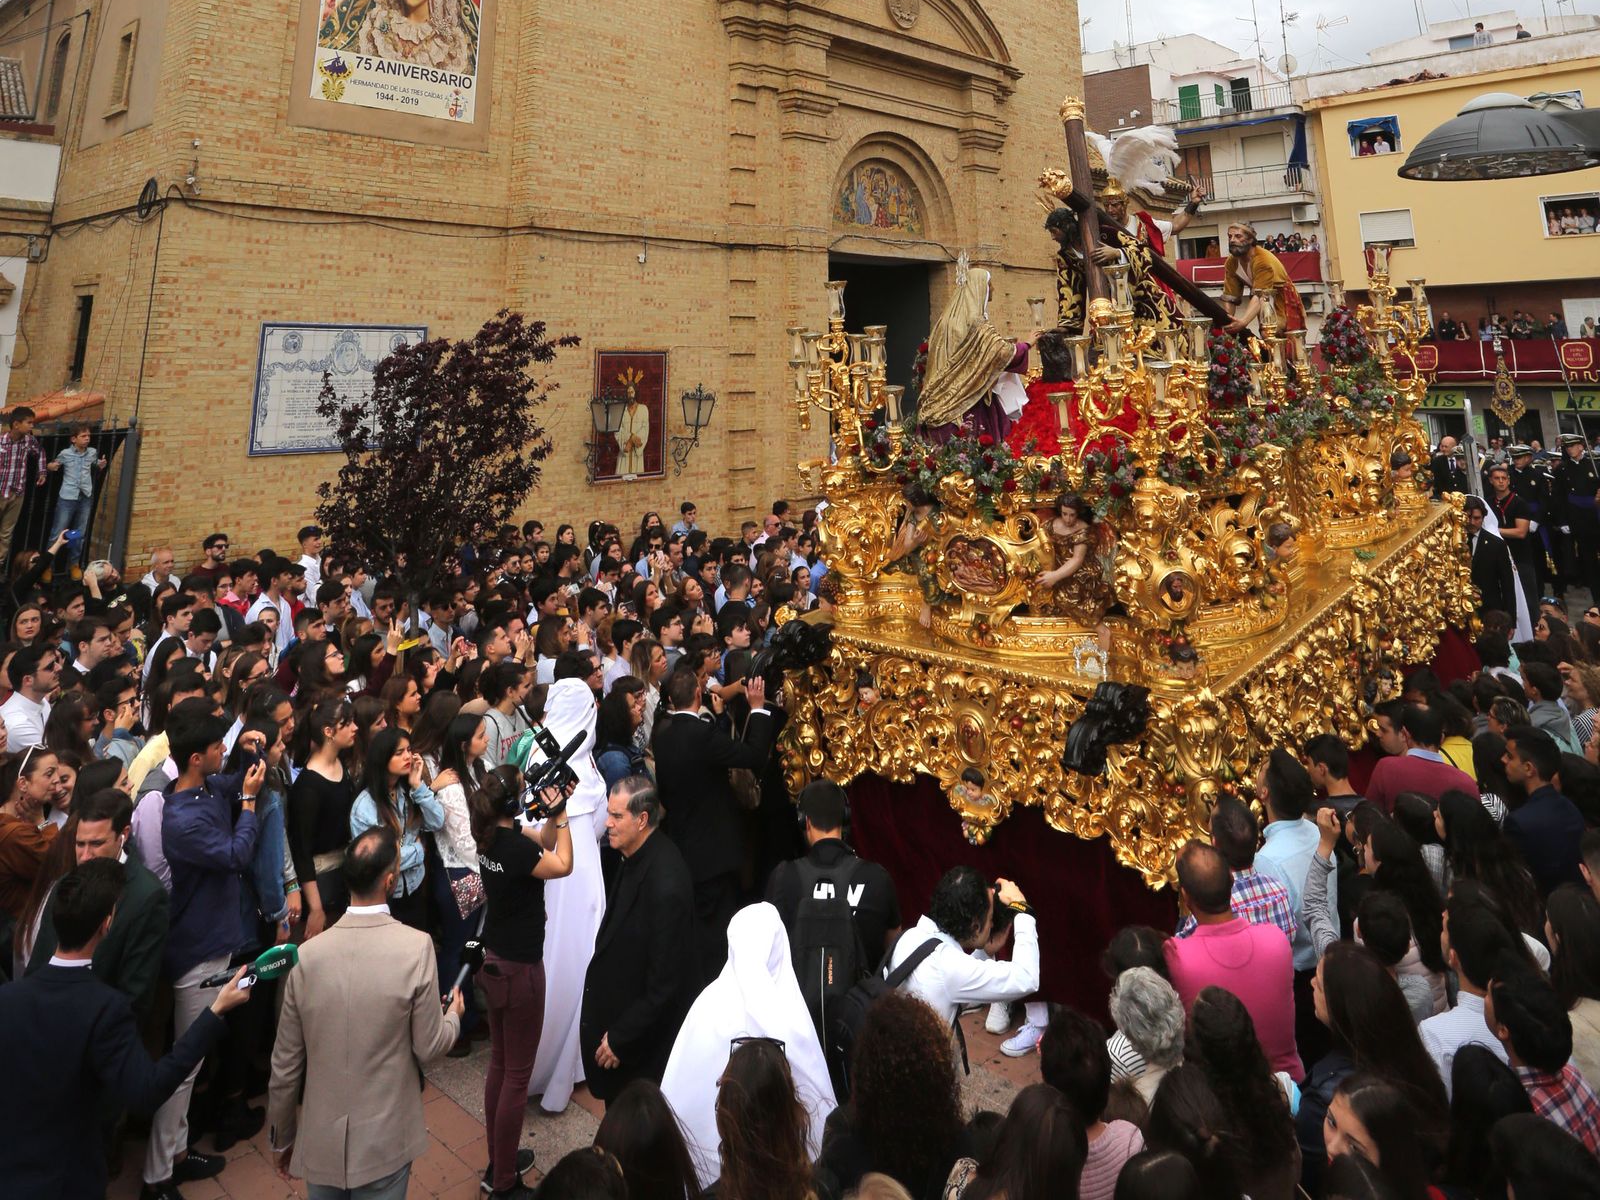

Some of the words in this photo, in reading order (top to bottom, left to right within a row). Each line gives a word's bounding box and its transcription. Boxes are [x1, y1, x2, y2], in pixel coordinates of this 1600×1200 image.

[356, 56, 372, 71] 75
[375, 60, 473, 89] ANIVERSARIO
[350, 79, 389, 90] HERMANDAD
[410, 89, 424, 97] TRES
[376, 92, 394, 101] 1944
[400, 96, 419, 106] 2019
[480, 854, 504, 872] ONUBA
